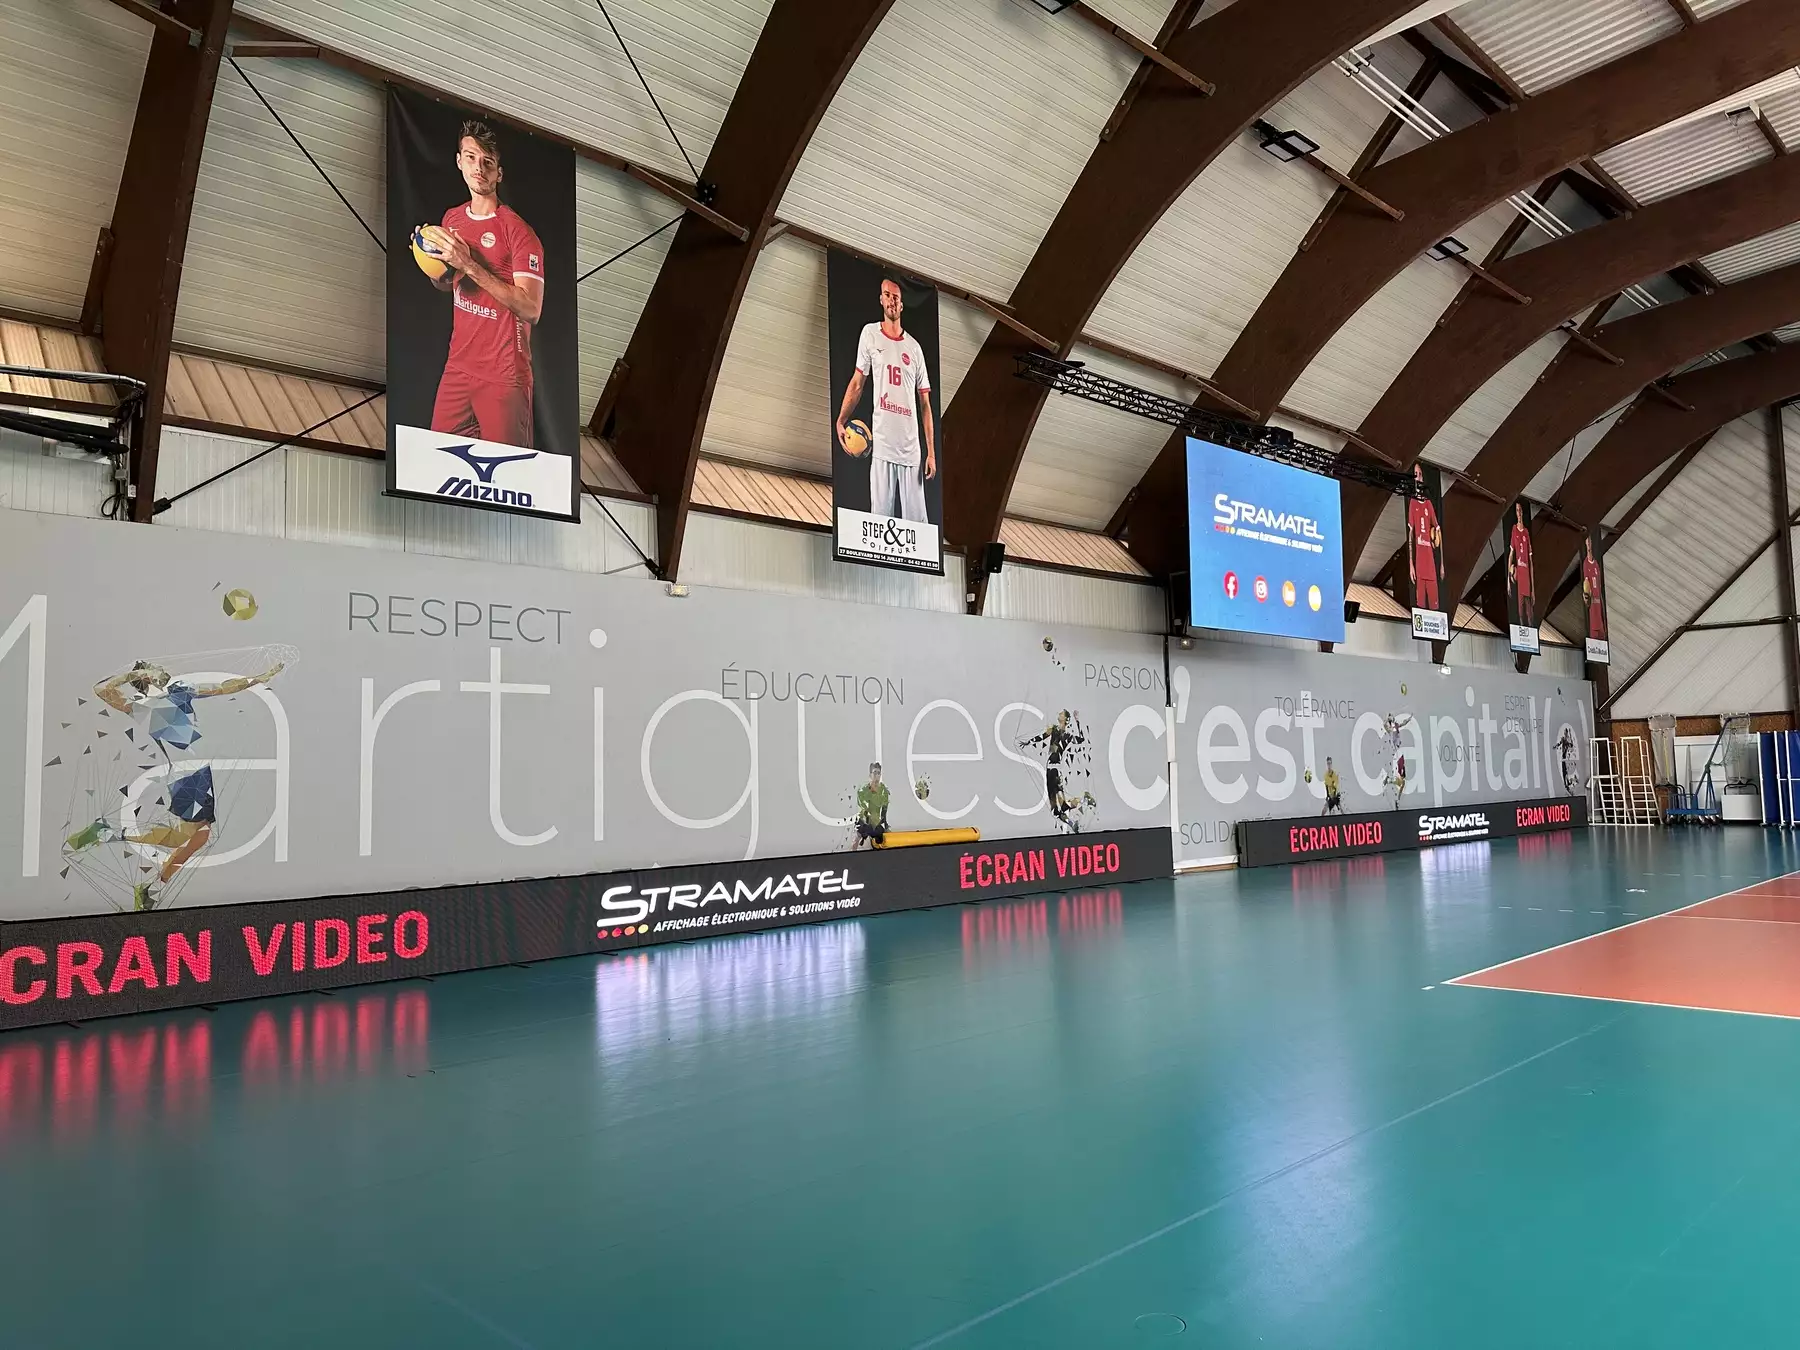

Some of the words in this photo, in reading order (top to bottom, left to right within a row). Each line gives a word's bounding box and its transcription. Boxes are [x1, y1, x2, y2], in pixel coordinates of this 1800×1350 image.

[887, 364, 902, 387] 16
[436, 476, 533, 508] MIZUNO
[1213, 494, 1325, 541] STRAMATEL
[846, 549, 873, 558] BOULEVARD
[862, 537, 918, 554] COIFFURE
[347, 592, 571, 645] RESPECT
[721, 662, 905, 705] ÉDUCATION
[1084, 663, 1166, 691] PASSION
[1274, 694, 1355, 719] TOLÉRANCE
[1504, 695, 1531, 711] ESPRIT
[1436, 741, 1481, 762] VOLONTÉ
[1418, 812, 1490, 836] STRAMATEL
[1516, 806, 1545, 827] ÉCRAN
[1546, 804, 1570, 823] VIDEO
[1289, 825, 1340, 853] ÉCRAN
[1342, 821, 1382, 847] VIDEO
[959, 849, 1046, 889] ÉCRAN
[1053, 843, 1121, 878] VIDEO
[596, 869, 865, 928] STRAMATEL
[653, 916, 710, 933] AFFICHAGE
[711, 907, 779, 926] ÉLECTRONIQUE
[780, 905, 787, 917] &
[789, 900, 835, 916] SOLUTIONS
[836, 896, 861, 910] VIDÉO
[242, 910, 430, 977] VIDEO
